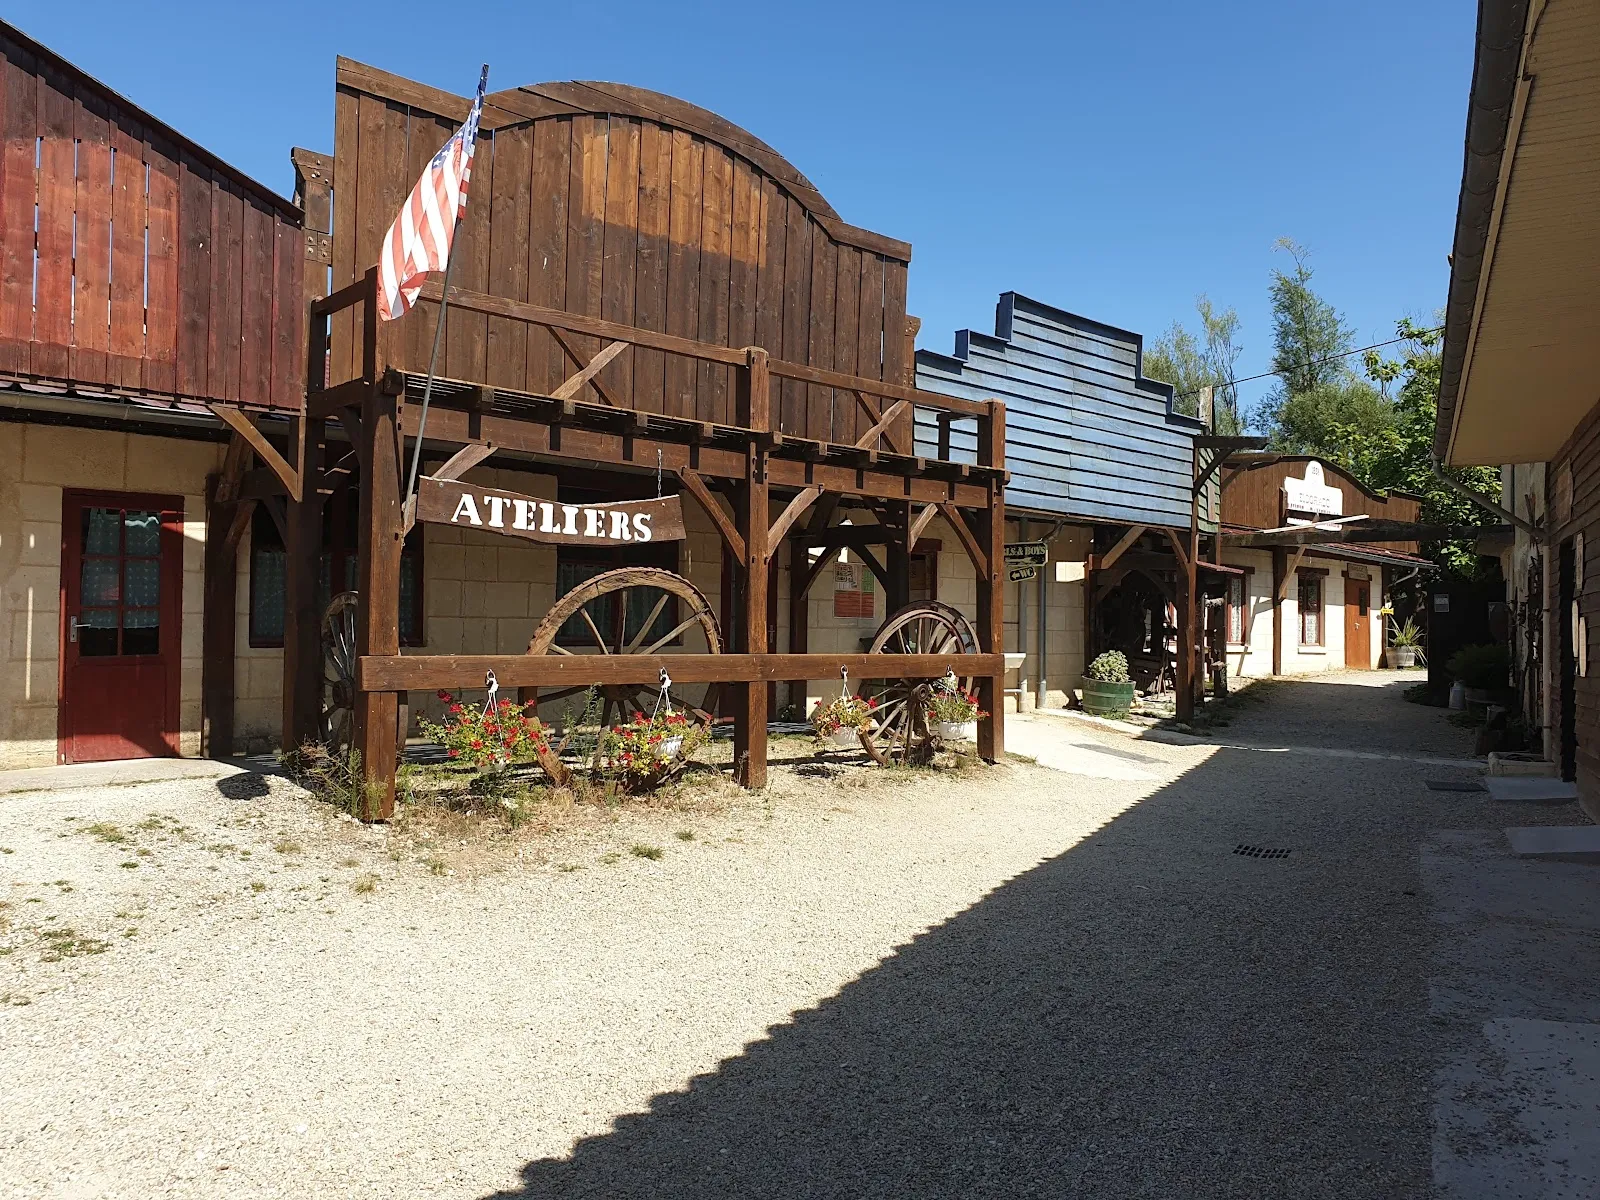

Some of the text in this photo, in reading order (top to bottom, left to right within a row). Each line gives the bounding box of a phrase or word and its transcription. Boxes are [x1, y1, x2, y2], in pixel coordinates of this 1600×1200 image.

[451, 493, 652, 543] ATELIERS
[1025, 545, 1046, 555] BOYS
[1019, 567, 1034, 578] WC
